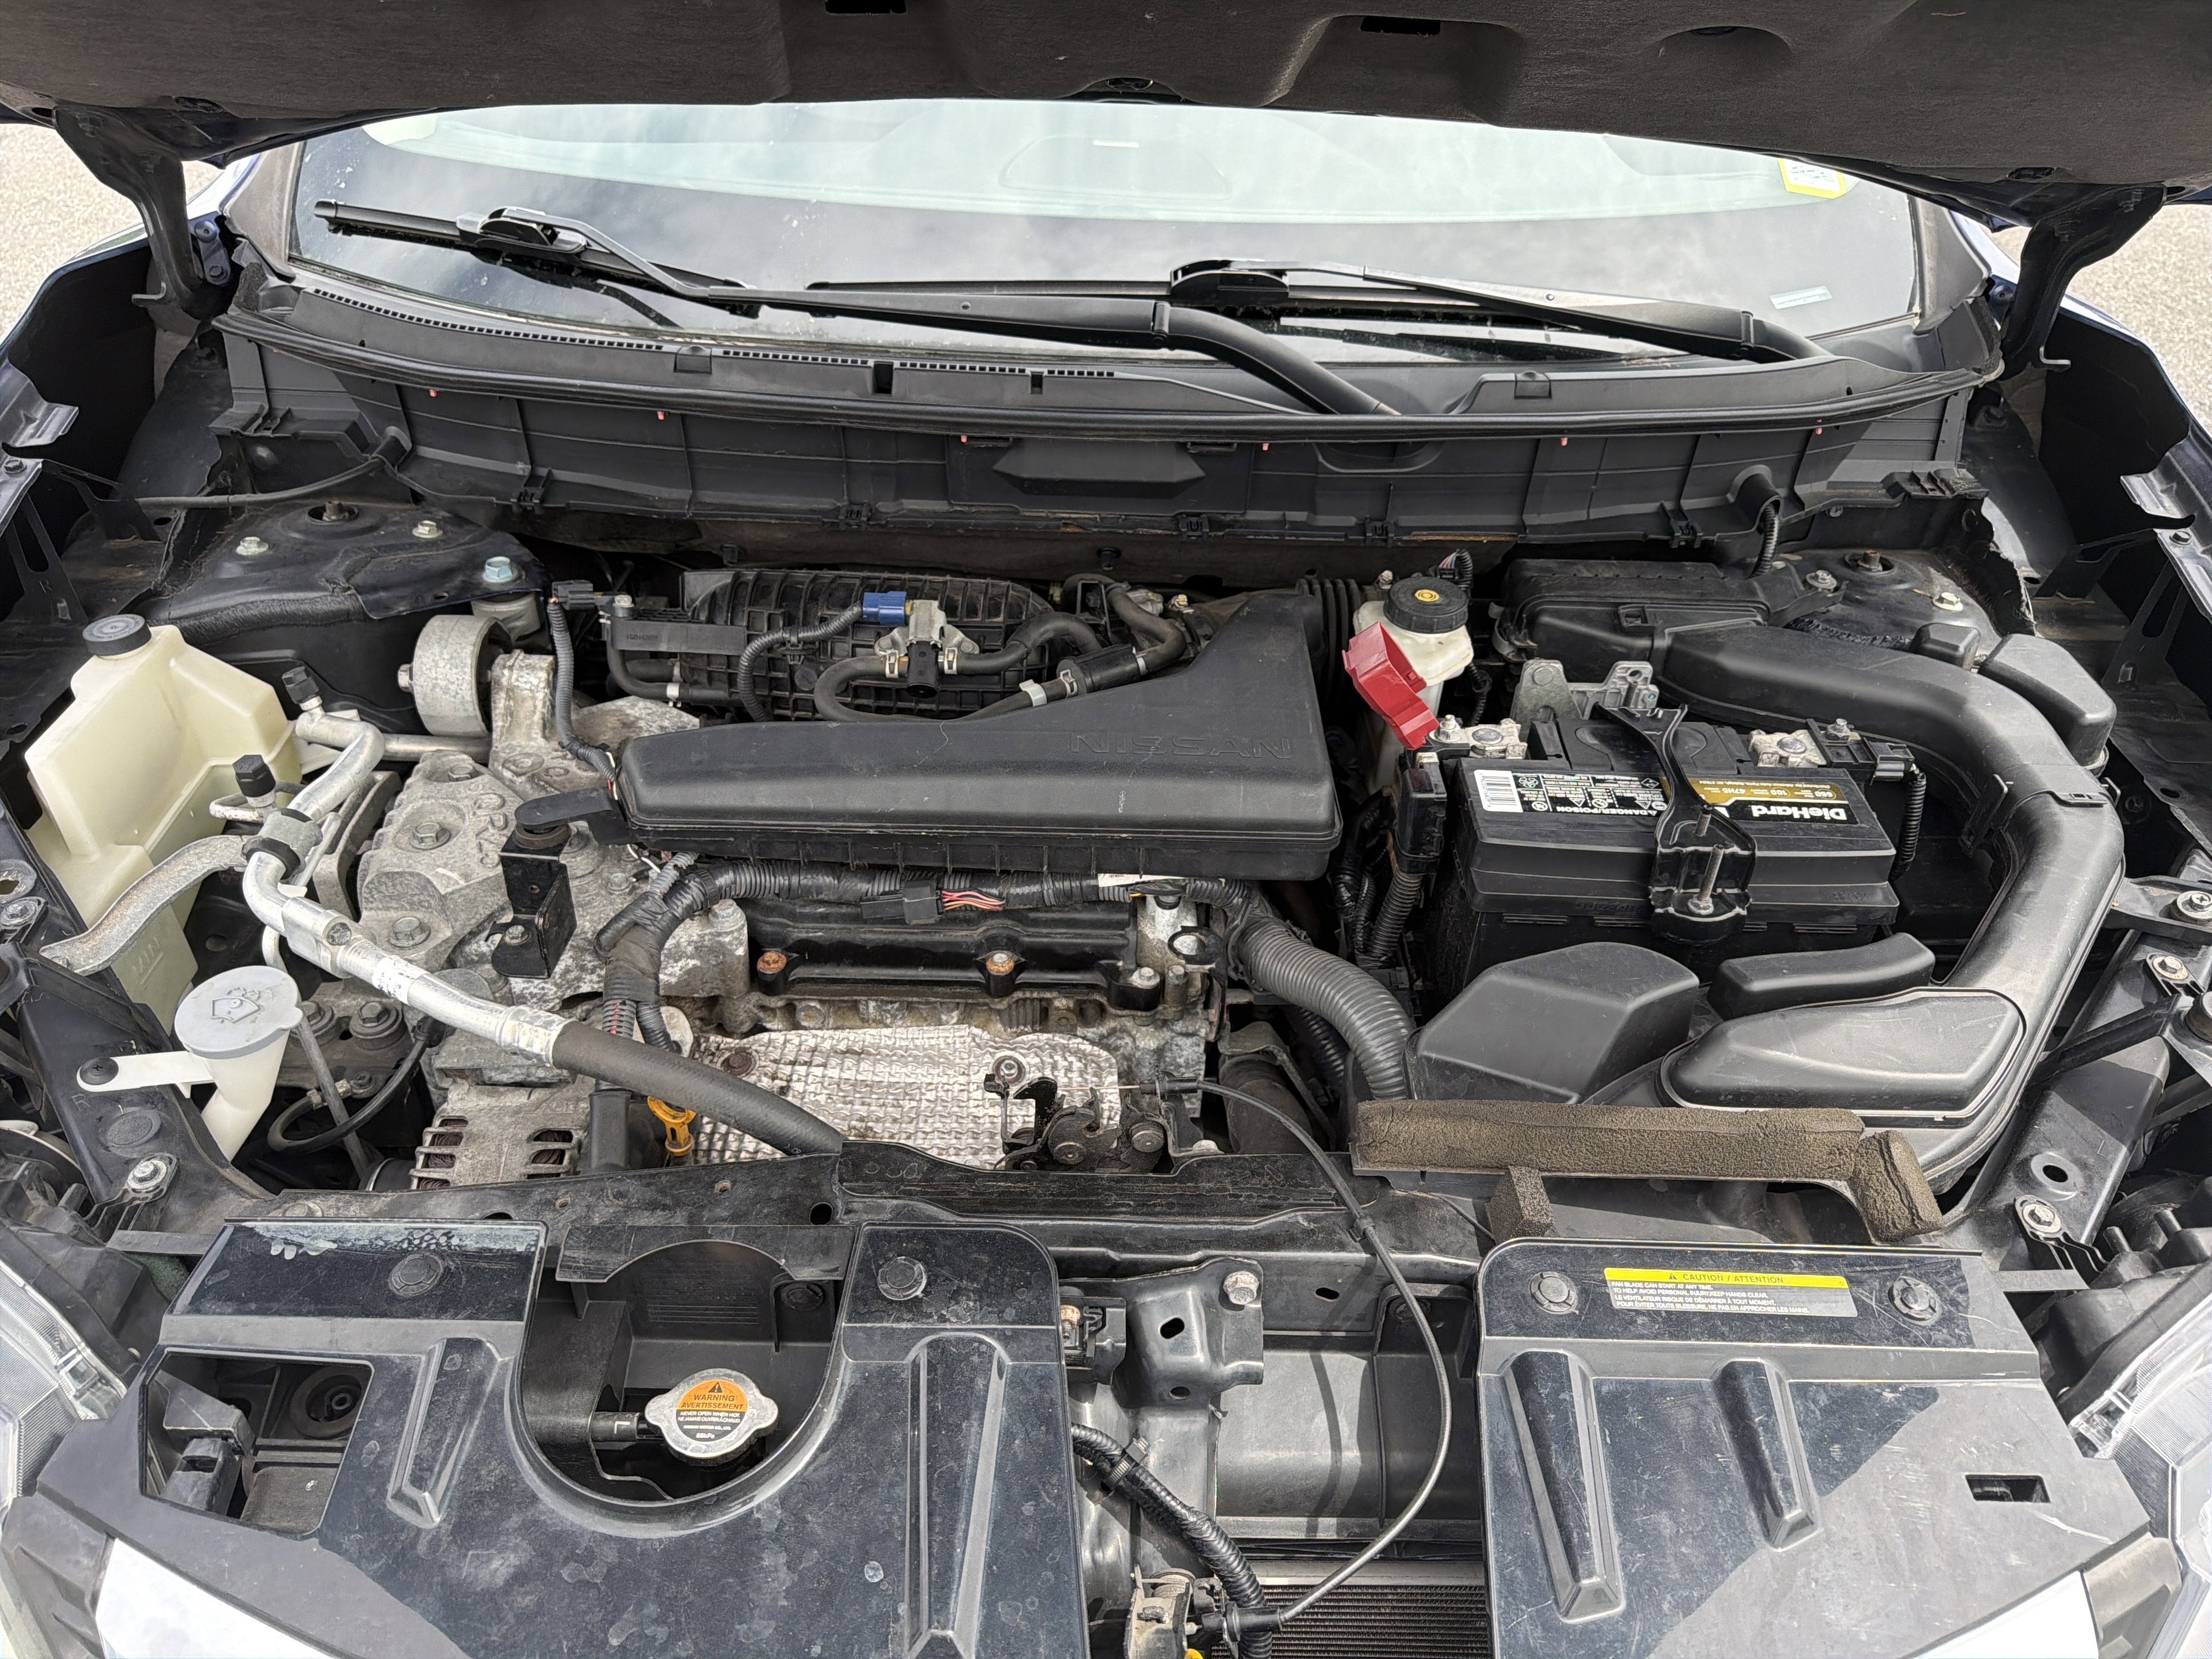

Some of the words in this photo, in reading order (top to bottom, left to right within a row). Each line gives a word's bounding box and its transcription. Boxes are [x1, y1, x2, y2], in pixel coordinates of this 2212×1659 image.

[1071, 732, 1292, 759] NISSAN
[1556, 806, 1648, 815] DANGER/POISON
[1751, 805, 1847, 820] DieHard
[71, 1093, 91, 1111] R
[1683, 1273, 1724, 1282] CAUTION
